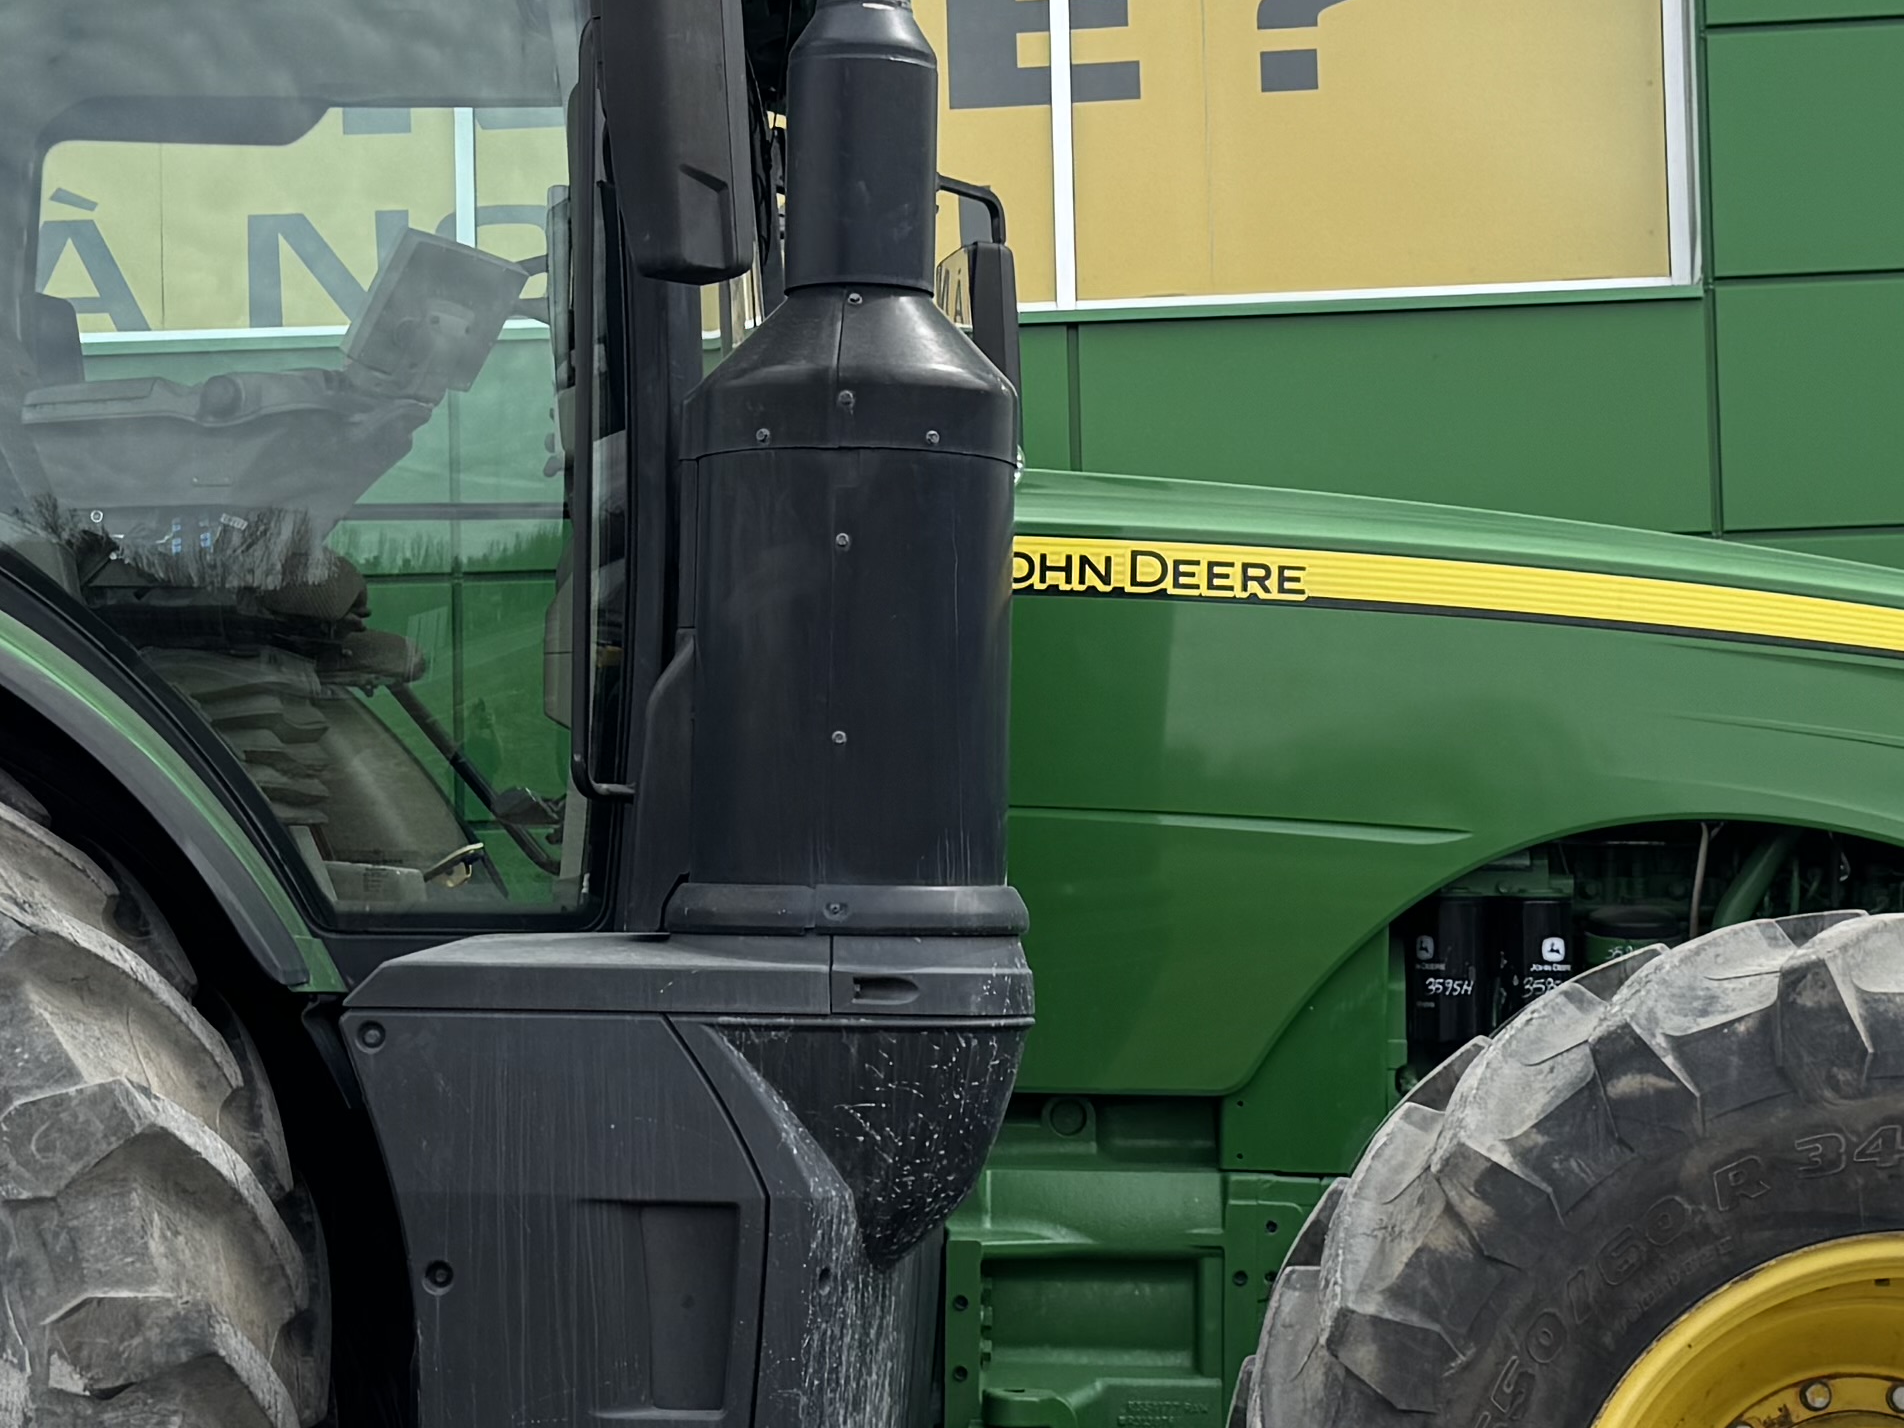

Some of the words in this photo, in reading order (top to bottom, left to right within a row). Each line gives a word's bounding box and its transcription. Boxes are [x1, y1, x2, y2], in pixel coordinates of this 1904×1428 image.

[1013, 551, 1112, 586] OHN
[1129, 549, 1308, 596] DEERE
[1425, 977, 1474, 996] 3595H
